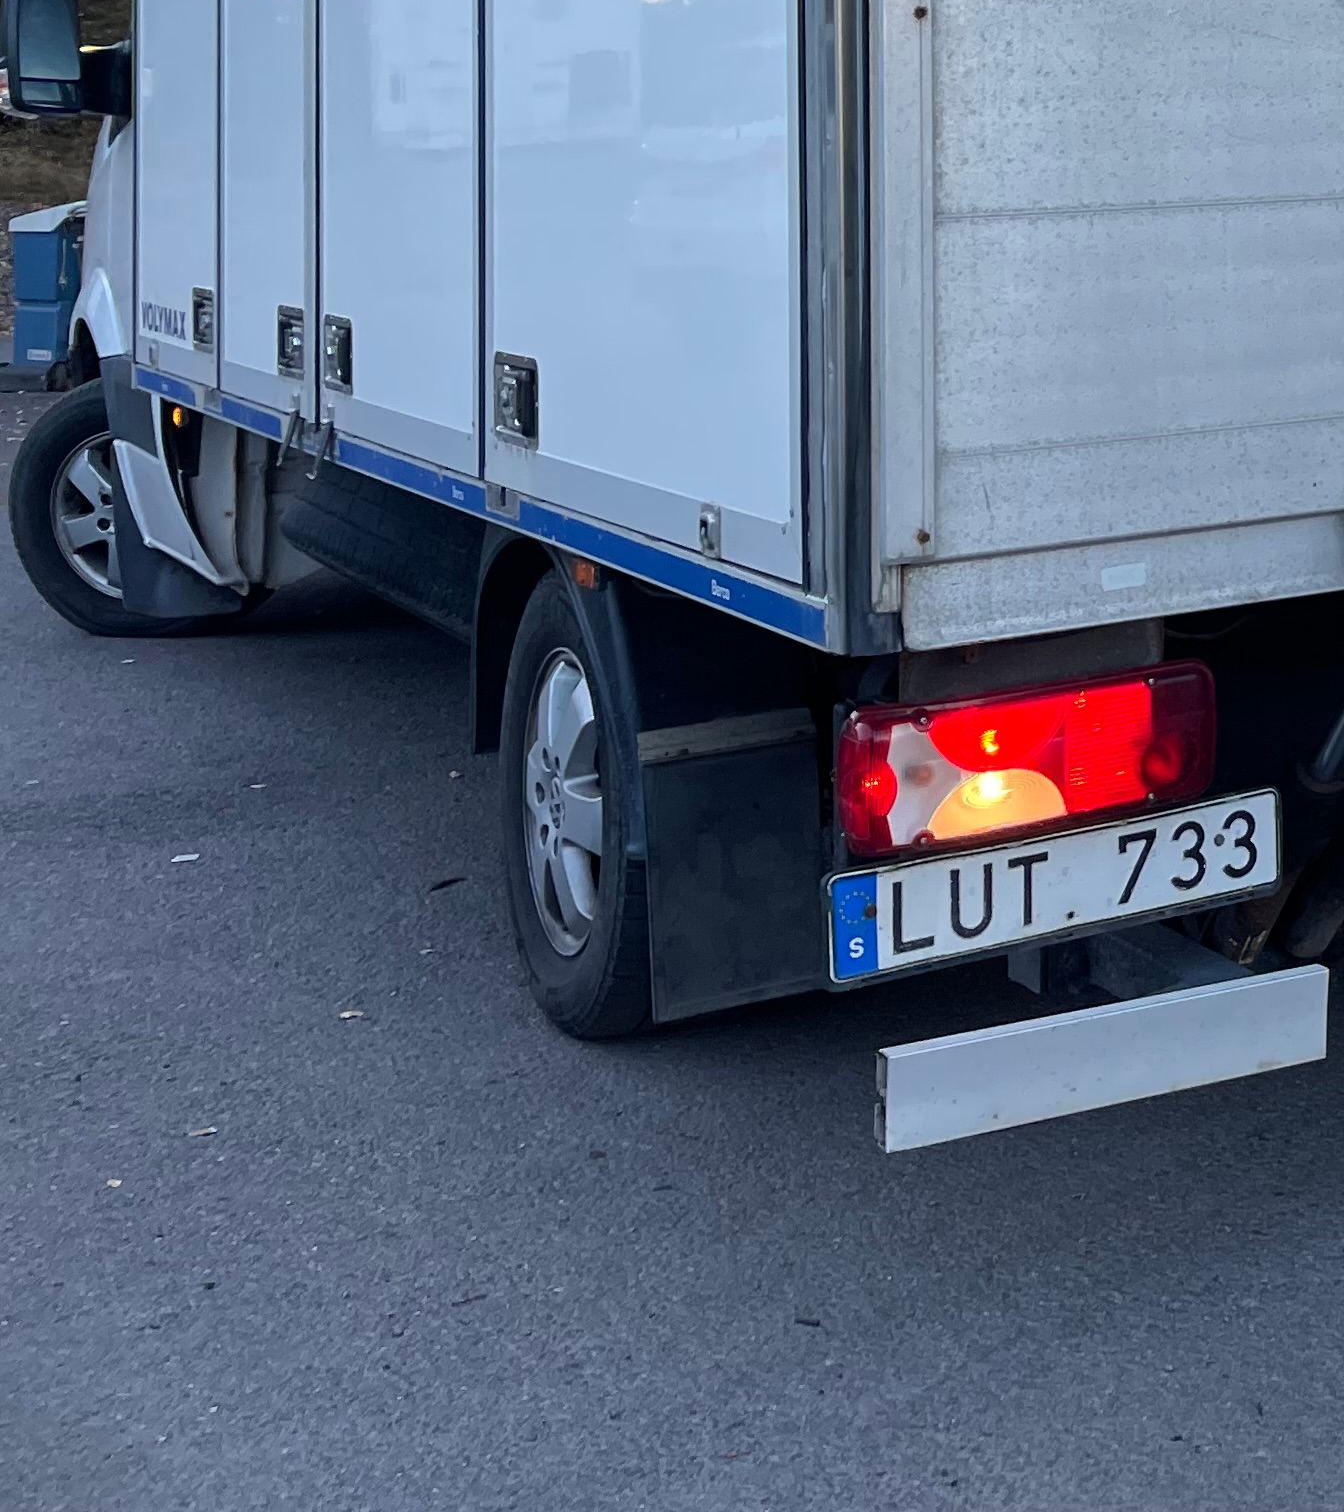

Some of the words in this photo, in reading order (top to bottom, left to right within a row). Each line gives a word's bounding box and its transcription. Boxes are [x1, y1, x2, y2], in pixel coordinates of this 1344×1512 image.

[141, 300, 187, 341] VOLYMAX
[1117, 809, 1258, 906] 733
[848, 936, 865, 960] S
